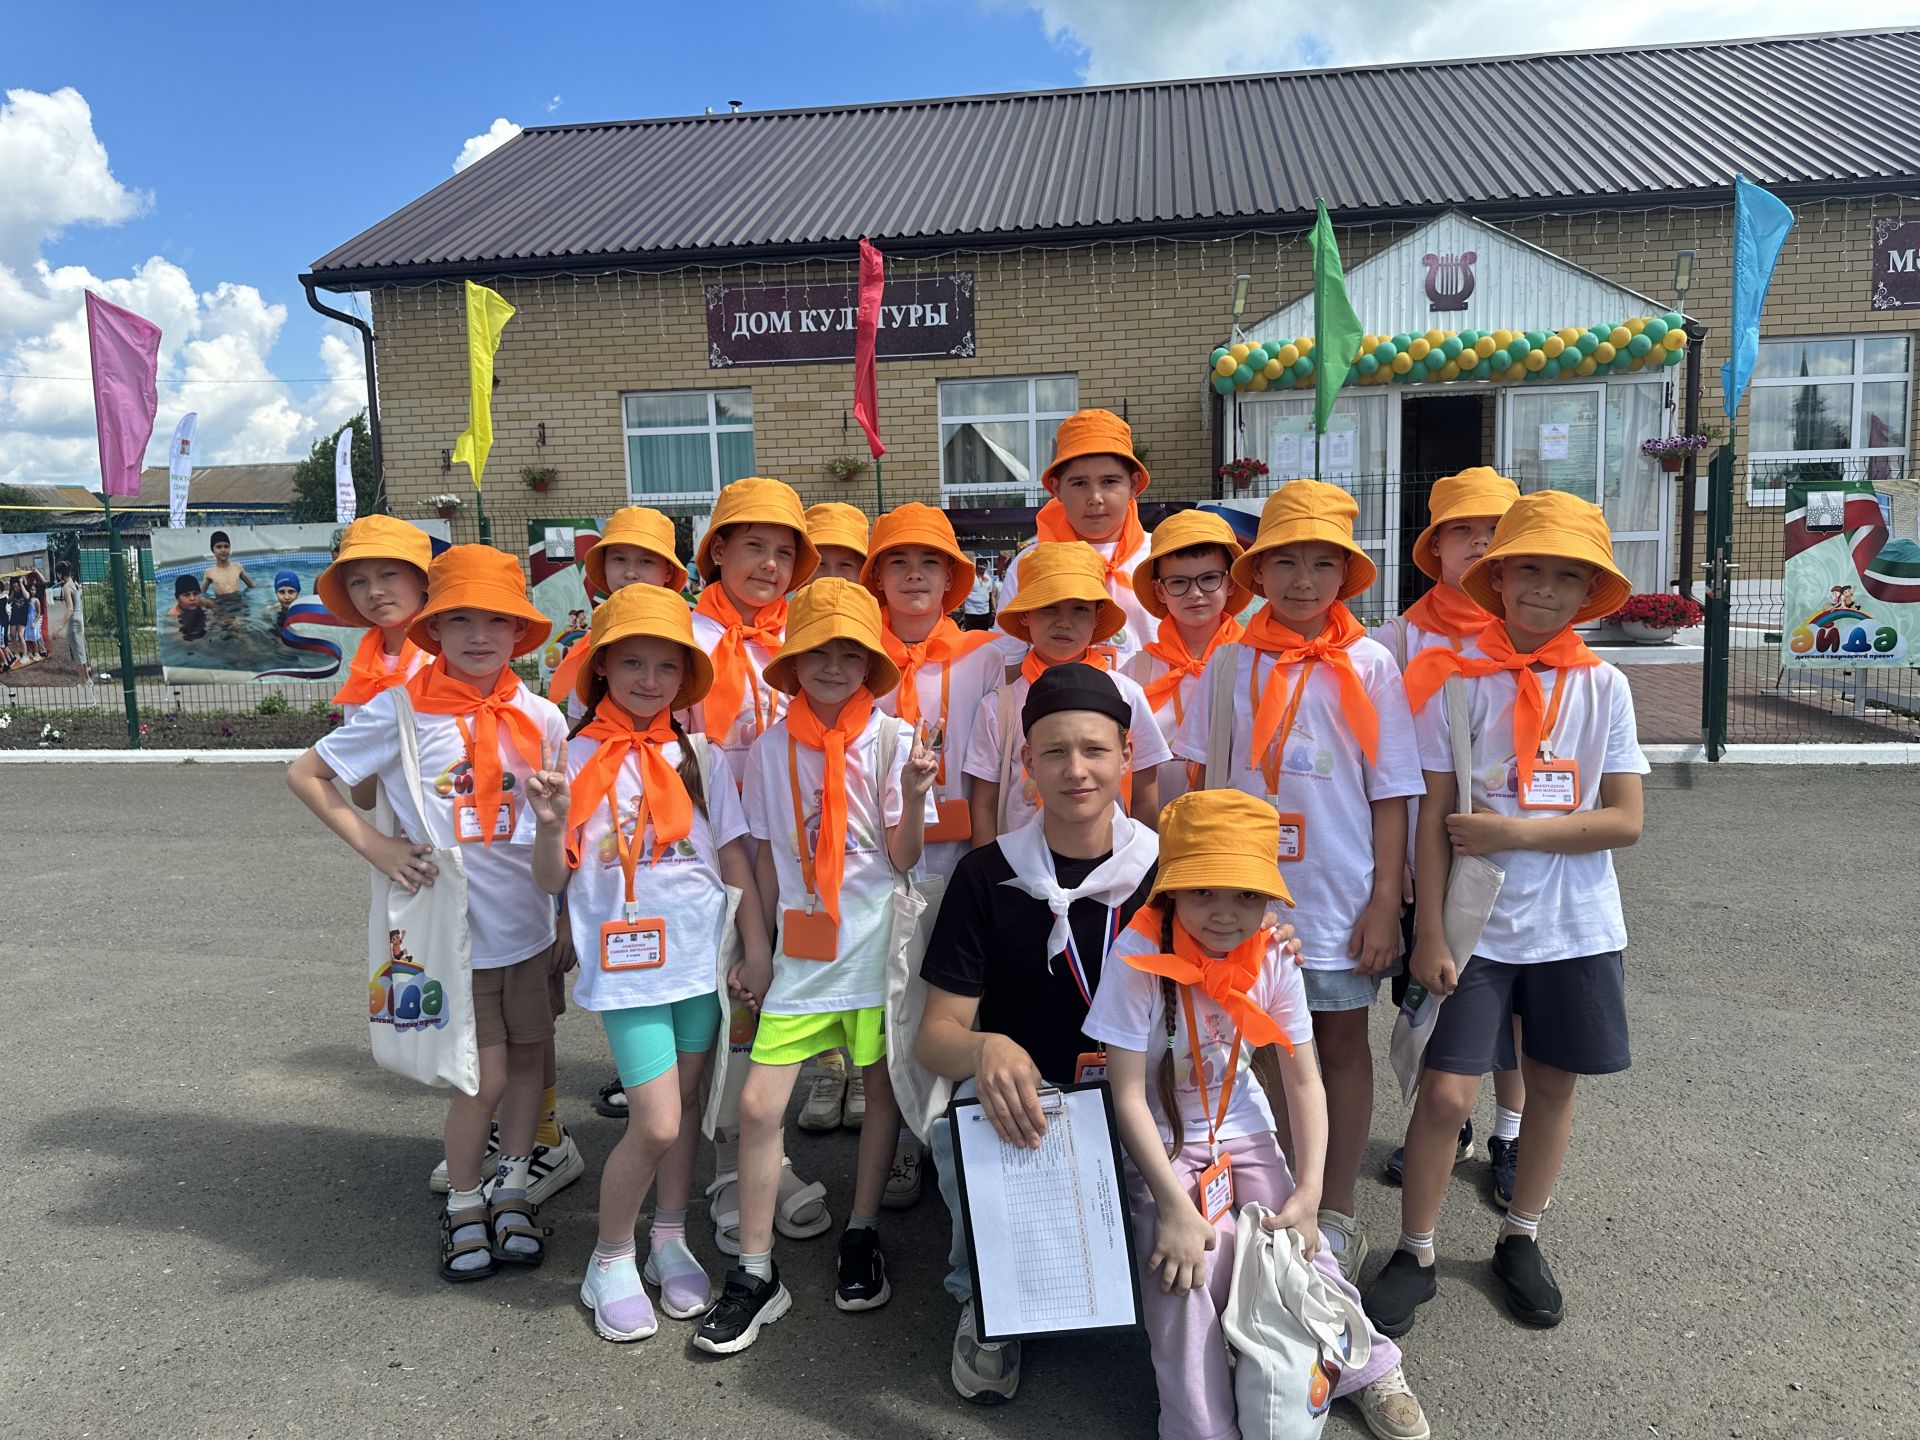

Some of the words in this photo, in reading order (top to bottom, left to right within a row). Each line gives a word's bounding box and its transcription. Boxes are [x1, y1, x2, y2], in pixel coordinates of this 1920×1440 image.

[1887, 248, 1920, 273] М
[731, 309, 792, 341] ДОМ
[798, 302, 949, 332] КУЛТУРЫ
